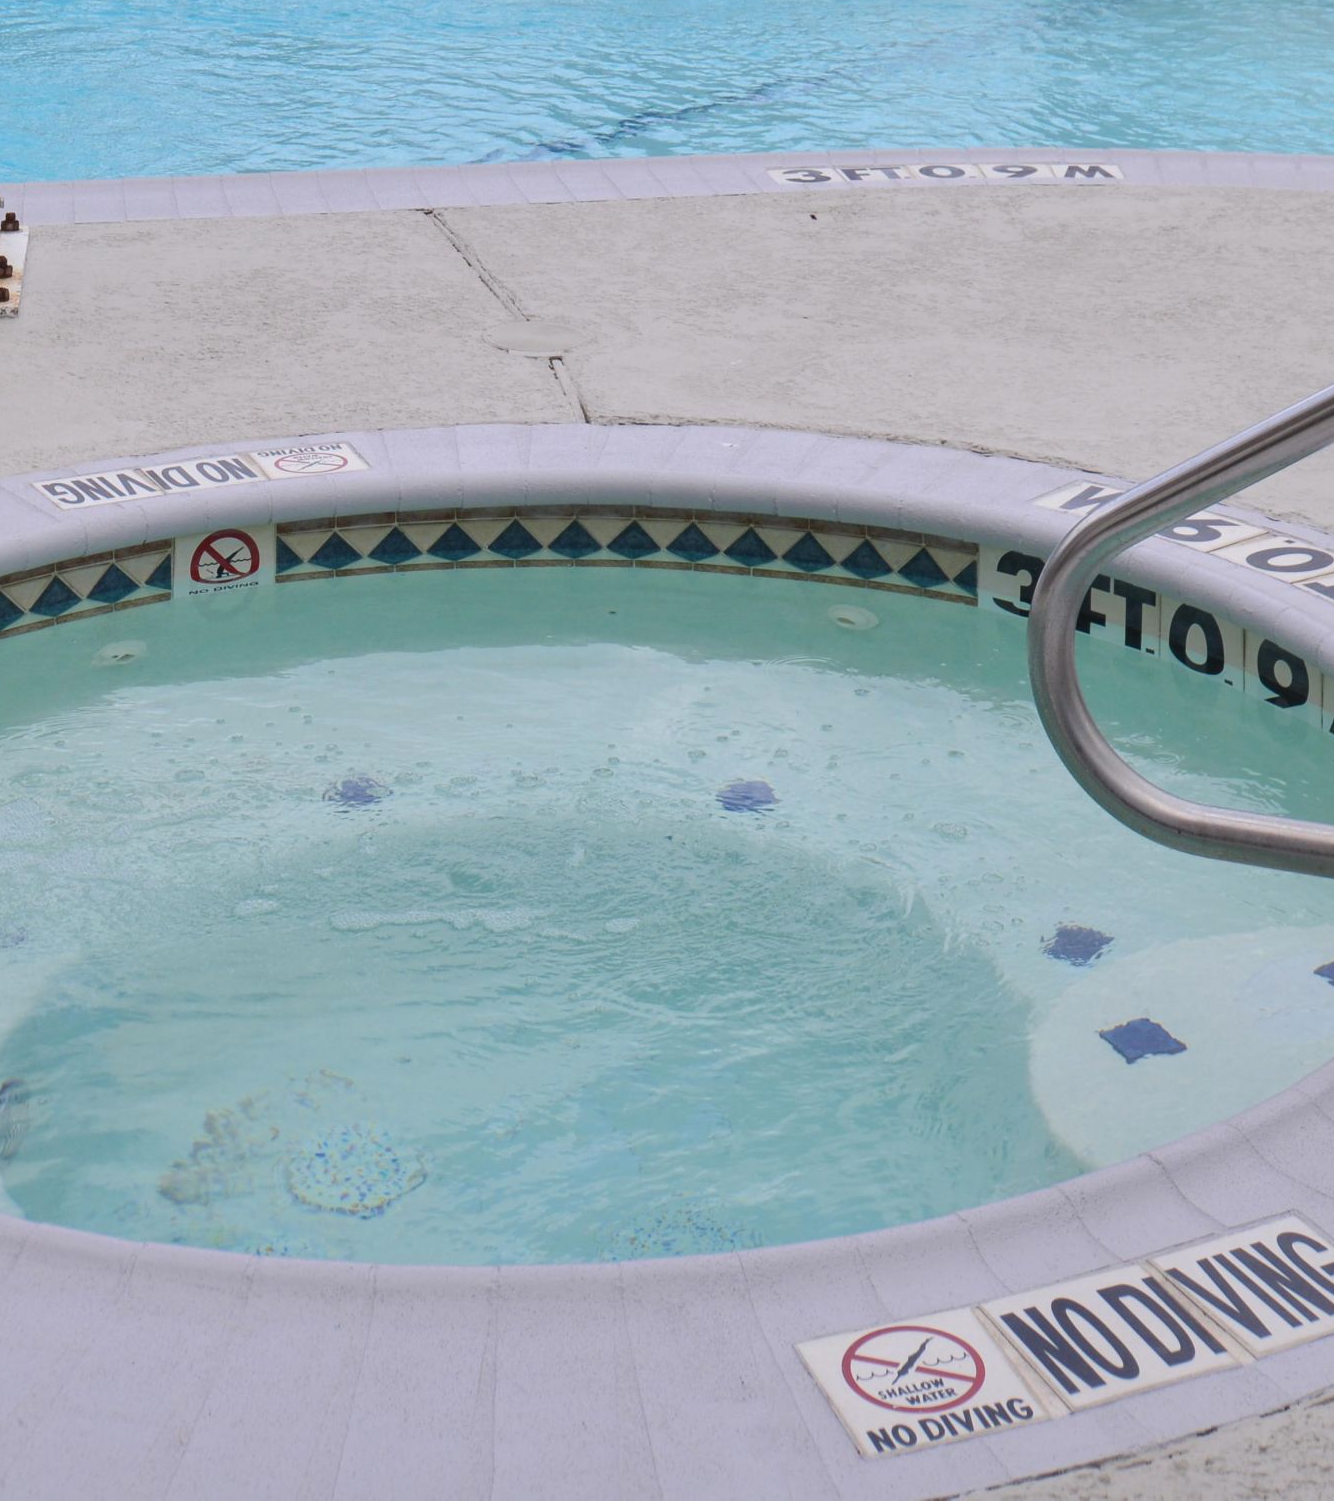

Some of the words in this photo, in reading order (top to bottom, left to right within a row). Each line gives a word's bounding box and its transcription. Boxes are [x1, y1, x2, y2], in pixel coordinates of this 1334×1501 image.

[782, 168, 831, 183] 3
[1064, 165, 1114, 179] M
[257, 447, 316, 457] DIVING
[319, 443, 343, 451] NO
[195, 457, 259, 483] NO
[41, 465, 199, 505] DIVING
[214, 581, 259, 591] DIVING
[993, 550, 1044, 617] 3
[999, 1296, 1141, 1395] NO
[878, 1378, 944, 1399] SHALLOW
[905, 1388, 958, 1405] WATER
[867, 1424, 918, 1453] NO
[918, 1398, 1034, 1442] DIVING
